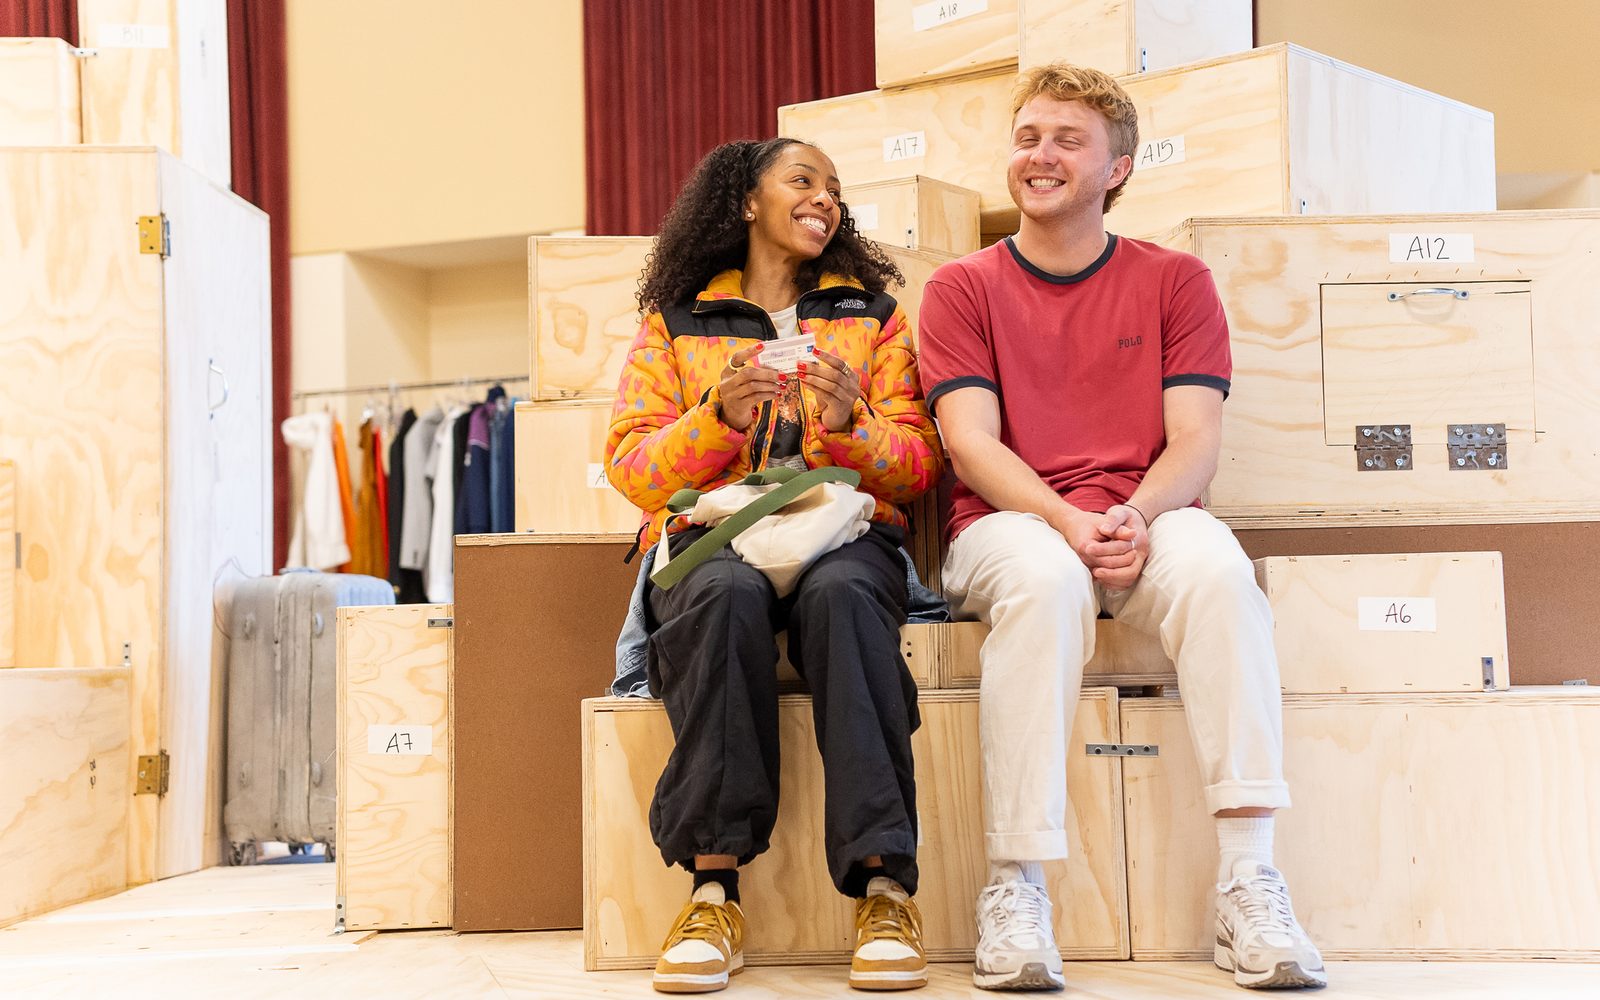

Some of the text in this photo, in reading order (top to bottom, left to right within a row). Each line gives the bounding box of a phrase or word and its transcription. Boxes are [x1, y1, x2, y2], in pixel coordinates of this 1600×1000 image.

[939, 2, 958, 20] A18
[890, 136, 918, 159] A17
[1141, 139, 1174, 165] A15
[1406, 236, 1450, 261] A12
[1118, 335, 1143, 350] POLO
[1385, 603, 1412, 624] A6
[385, 732, 413, 753] A7
